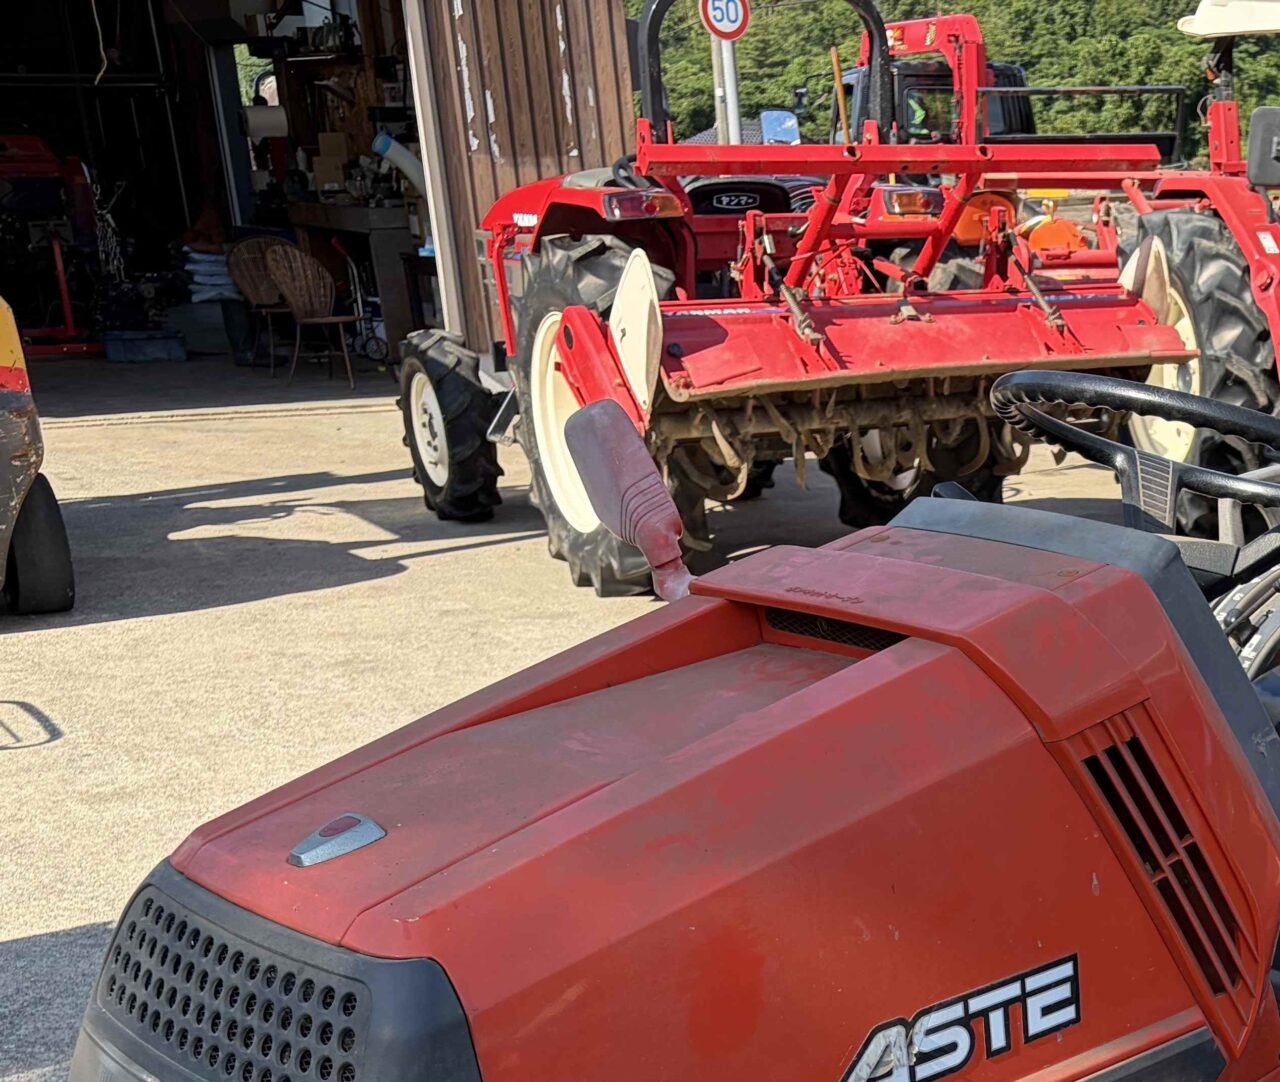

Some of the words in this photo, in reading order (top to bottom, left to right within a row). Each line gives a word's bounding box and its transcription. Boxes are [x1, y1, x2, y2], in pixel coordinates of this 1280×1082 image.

[711, 0, 739, 24] 50
[720, 196, 754, 205] ヤンマー
